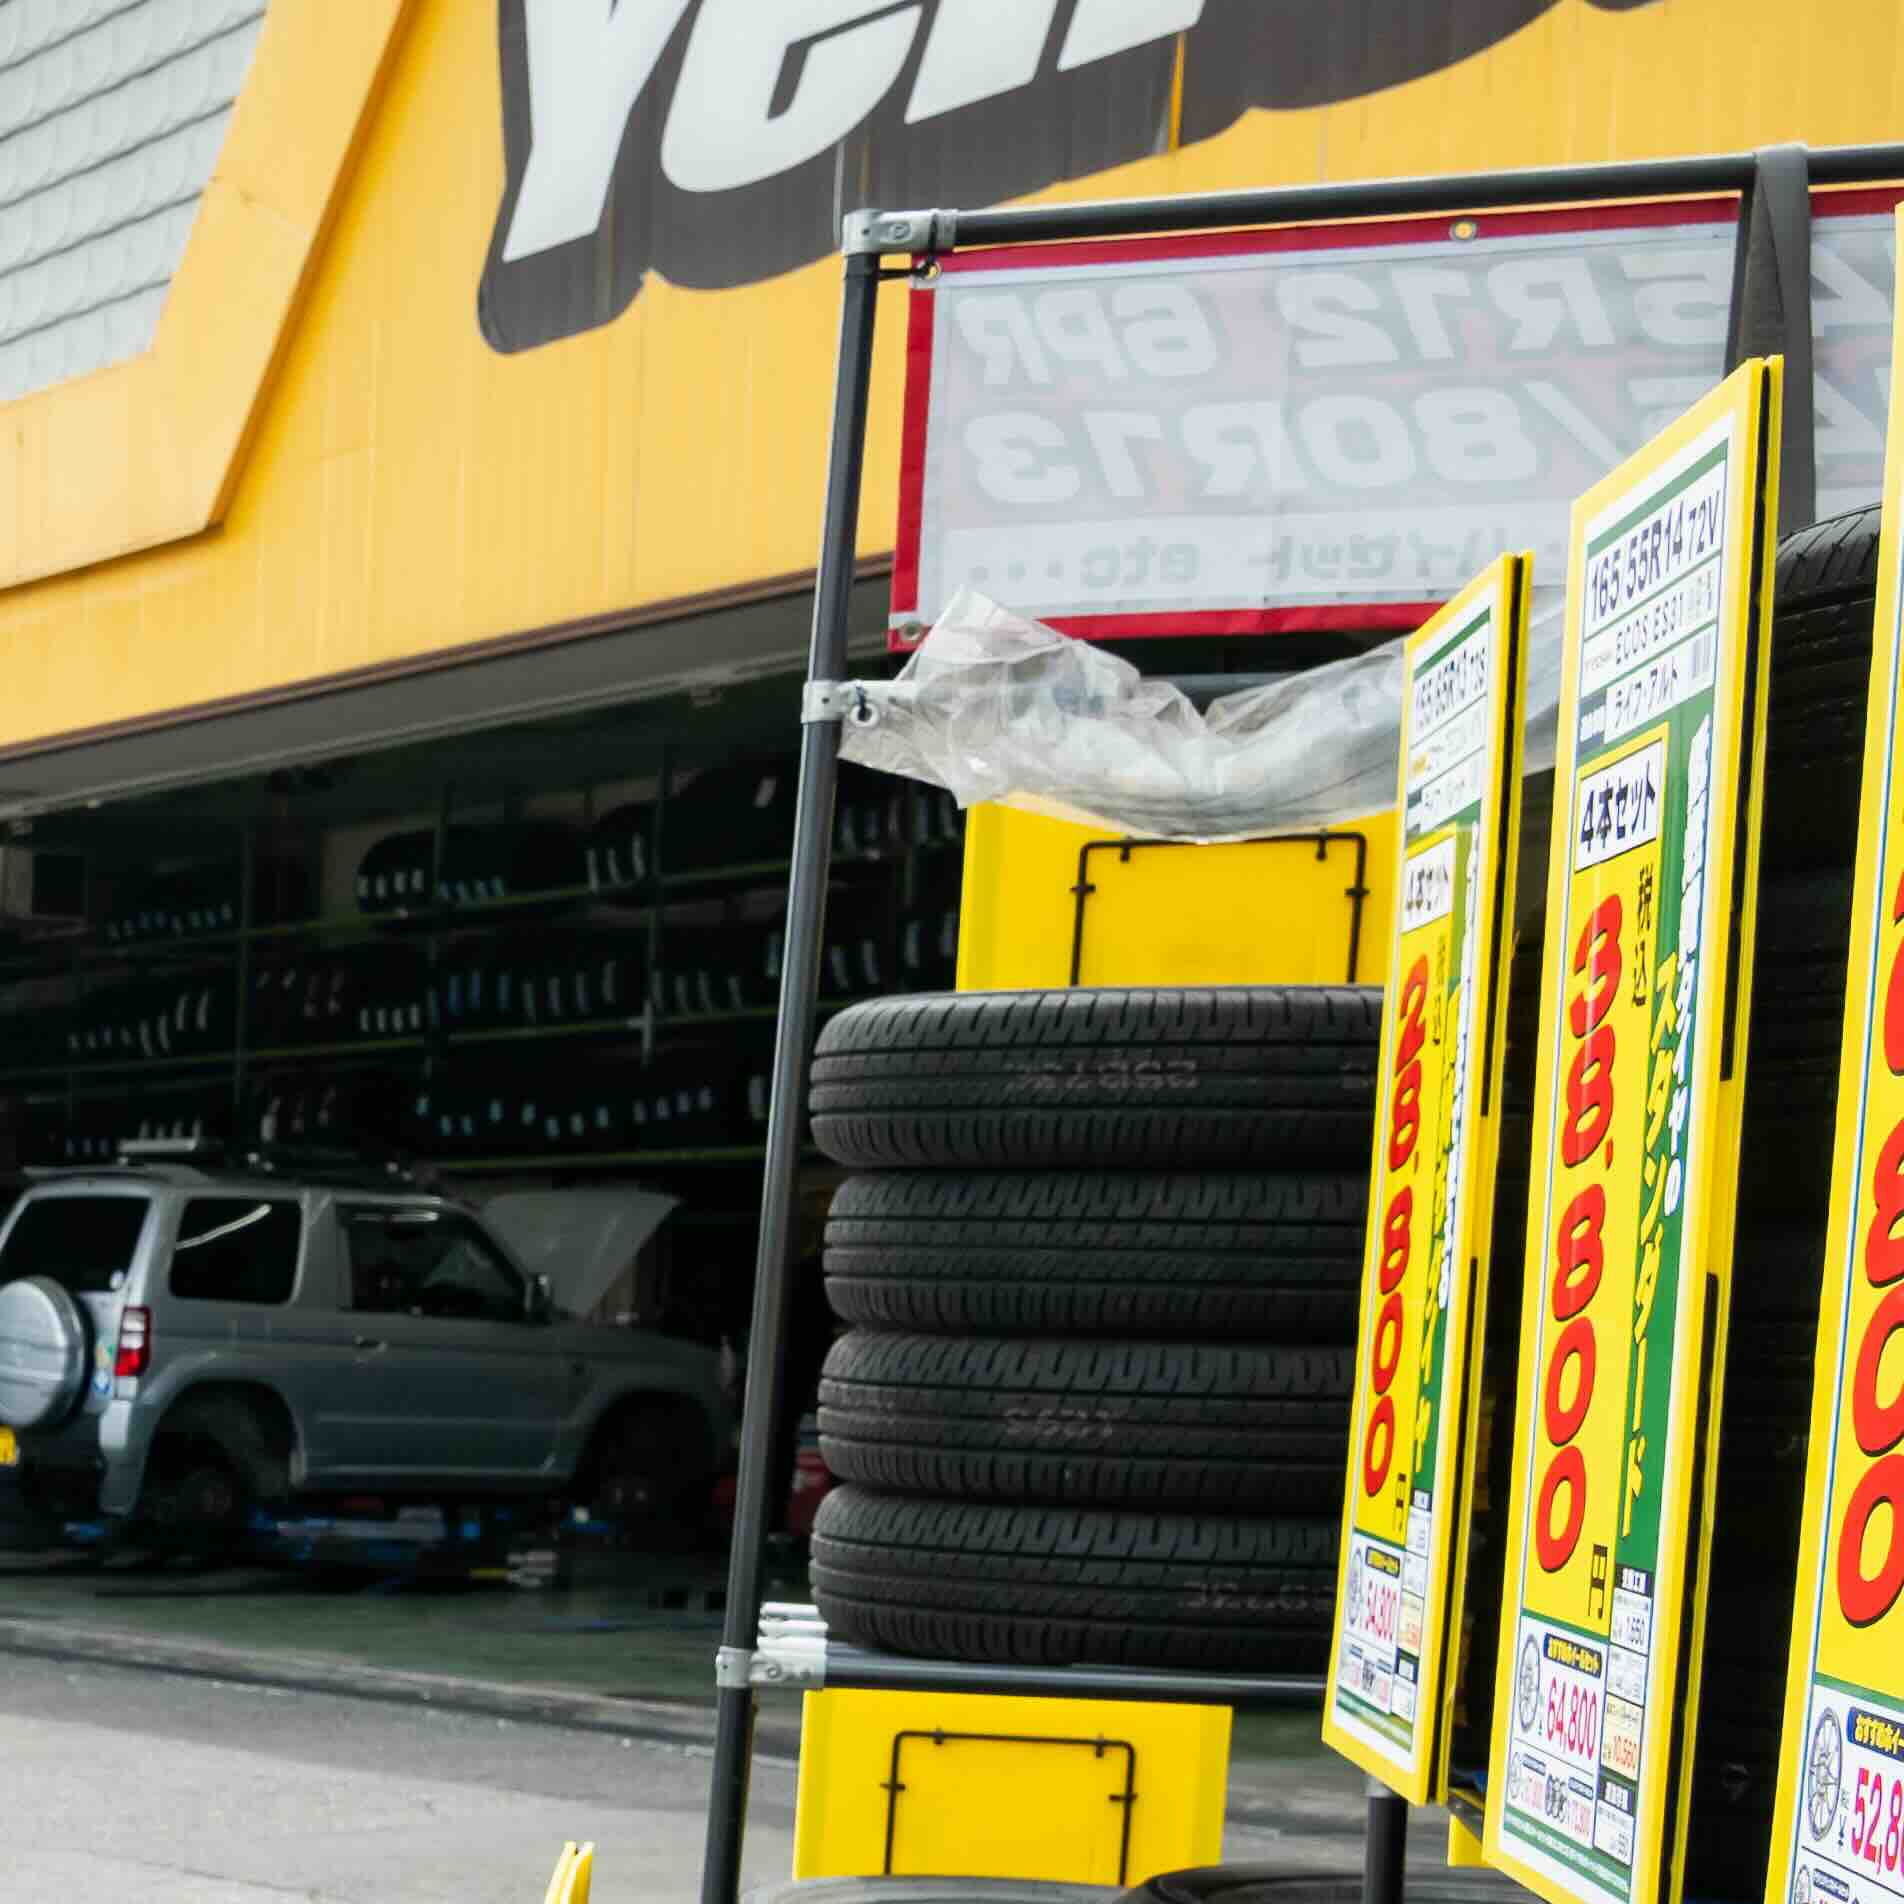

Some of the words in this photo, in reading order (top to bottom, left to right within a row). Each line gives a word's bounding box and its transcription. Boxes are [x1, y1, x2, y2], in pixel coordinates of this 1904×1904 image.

[1580, 758, 1656, 853] 4本セット
[1364, 954, 1428, 1498] 28,800
[1536, 892, 1623, 1572] 38,800
[1620, 951, 1679, 1539] スタンダード
[1546, 1676, 1599, 1762] 64,800
[1850, 1766, 1904, 1876] 52,8
